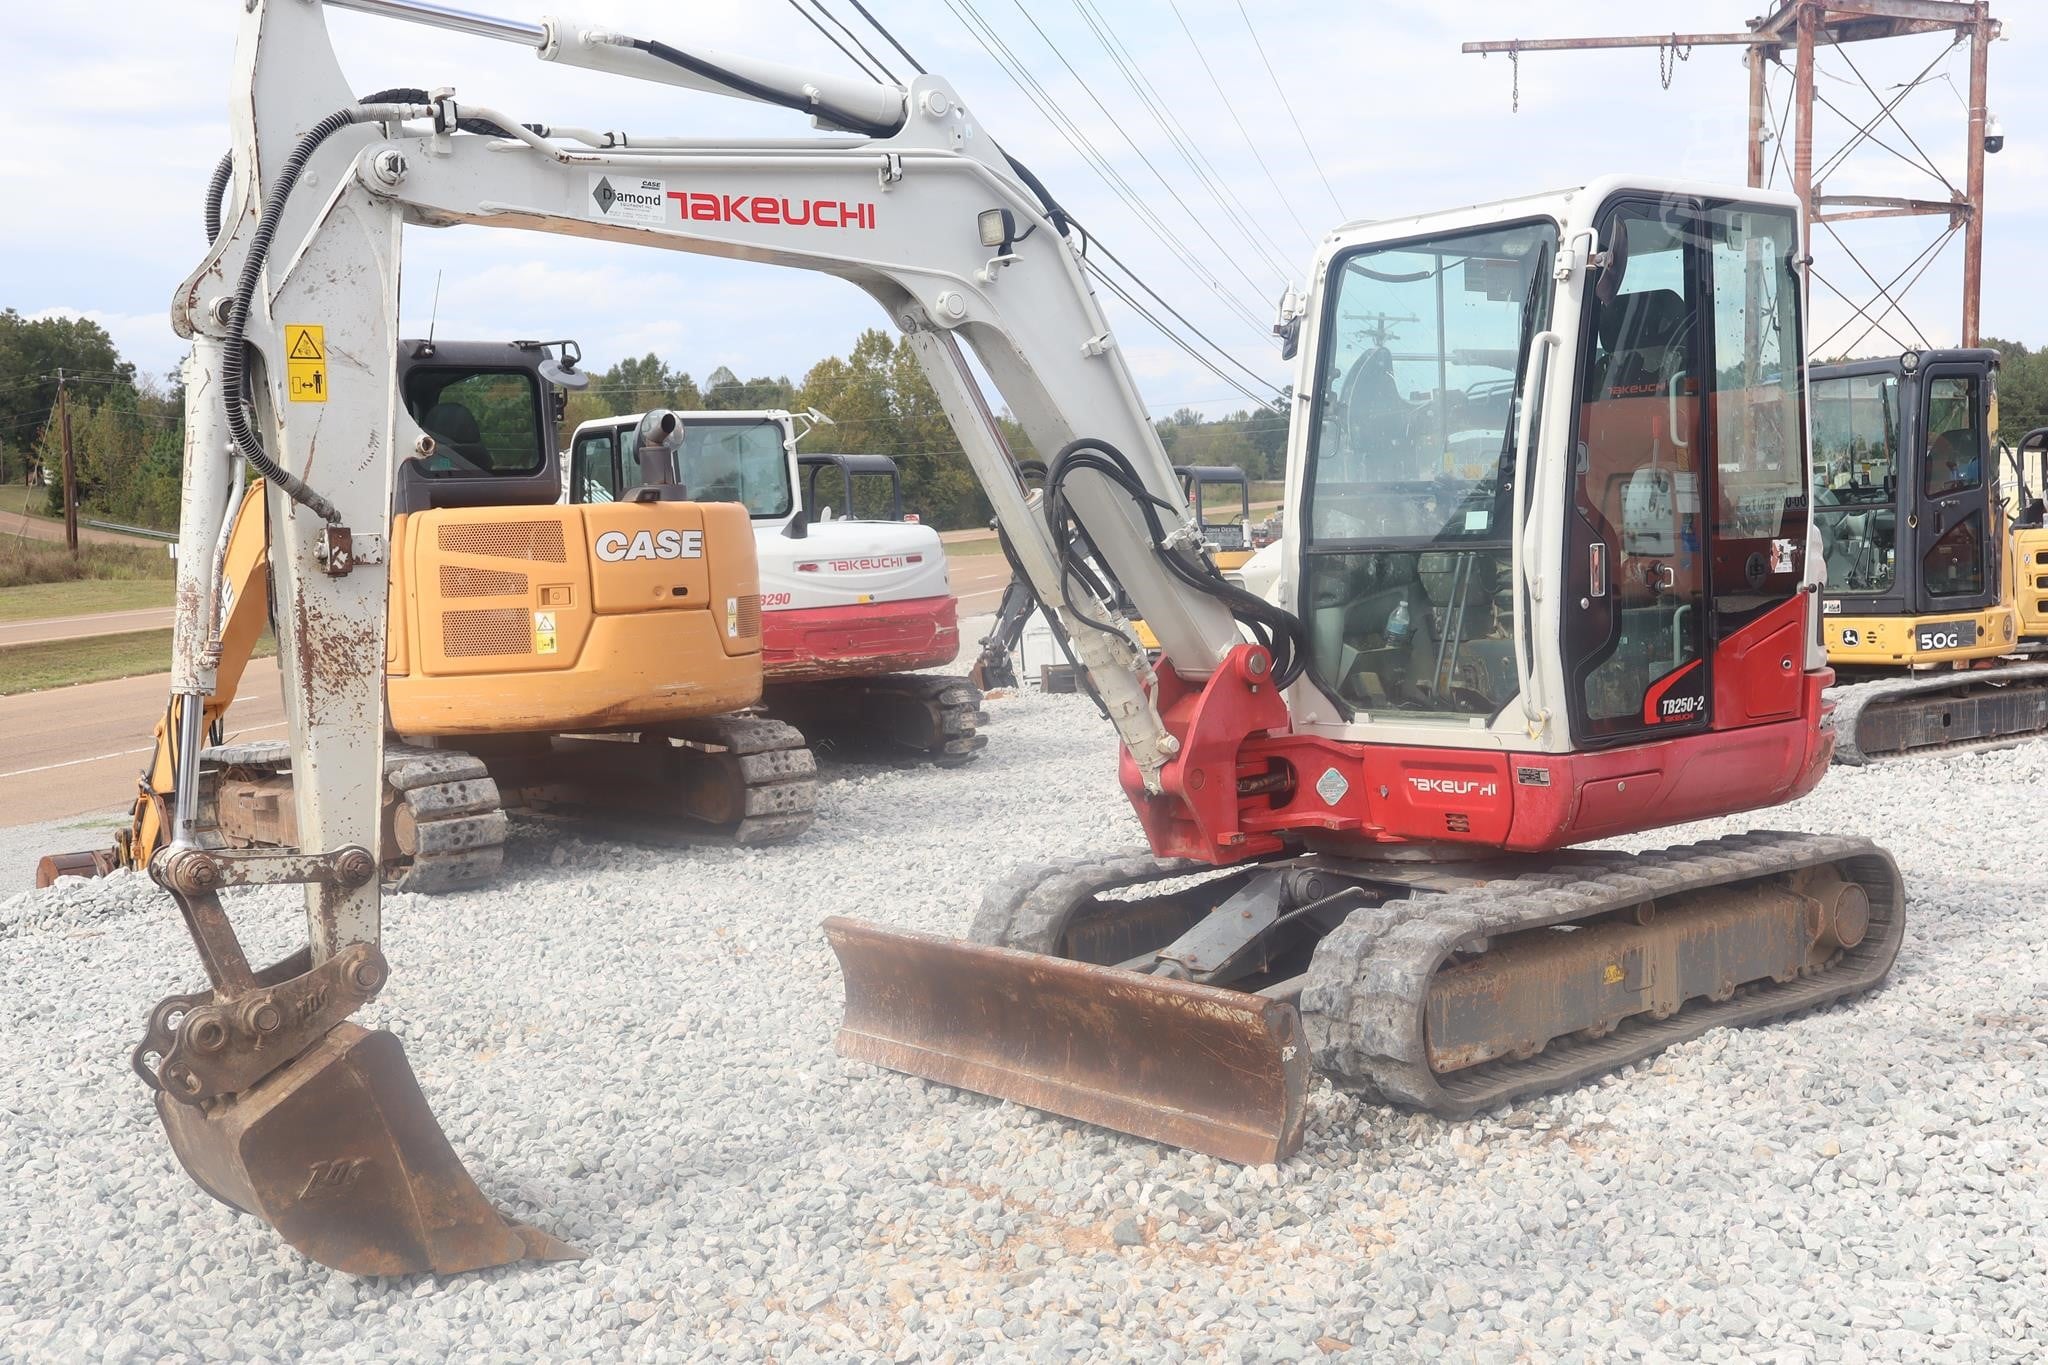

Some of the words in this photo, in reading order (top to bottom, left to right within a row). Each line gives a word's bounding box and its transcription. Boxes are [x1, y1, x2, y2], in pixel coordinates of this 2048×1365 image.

[603, 188, 661, 205] Diamond
[667, 191, 875, 229] TAKEUCHI
[1608, 383, 1667, 395] TAKEUCHI
[595, 530, 703, 562] CASE
[828, 556, 903, 572] TAKEUCHI
[1921, 632, 1958, 650] 50G
[1662, 695, 1705, 715] TB250-2
